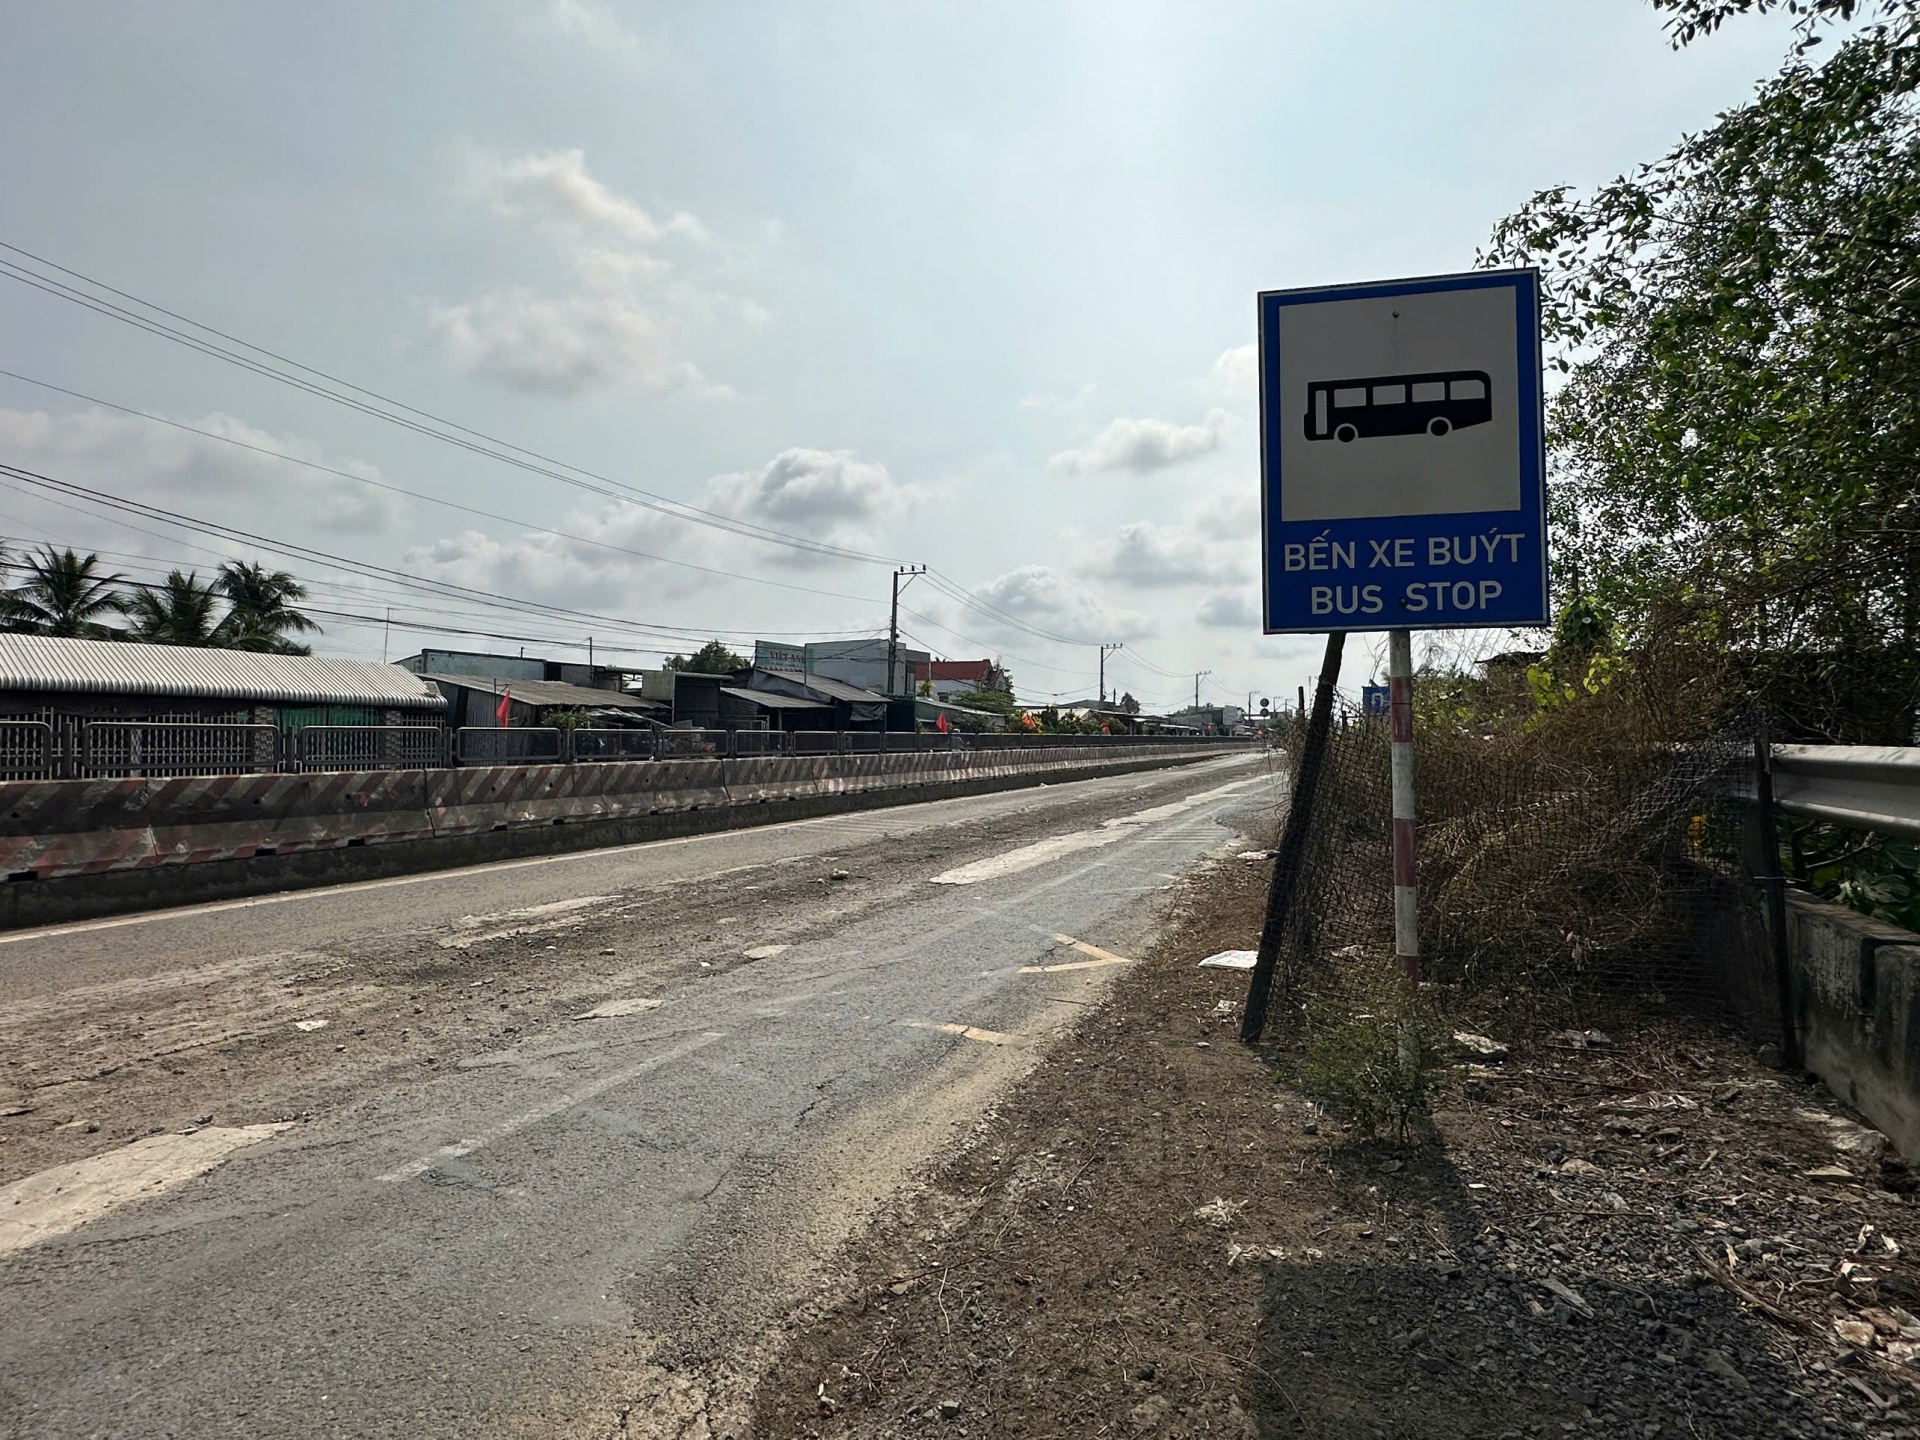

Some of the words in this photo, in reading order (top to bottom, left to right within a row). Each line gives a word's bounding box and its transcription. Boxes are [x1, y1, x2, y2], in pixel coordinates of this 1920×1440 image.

[1284, 529, 1355, 571] BẾN
[1369, 538, 1415, 568] XE
[1428, 527, 1525, 566] BUÝT
[1311, 585, 1383, 615] BUS
[1405, 580, 1503, 611] STOP
